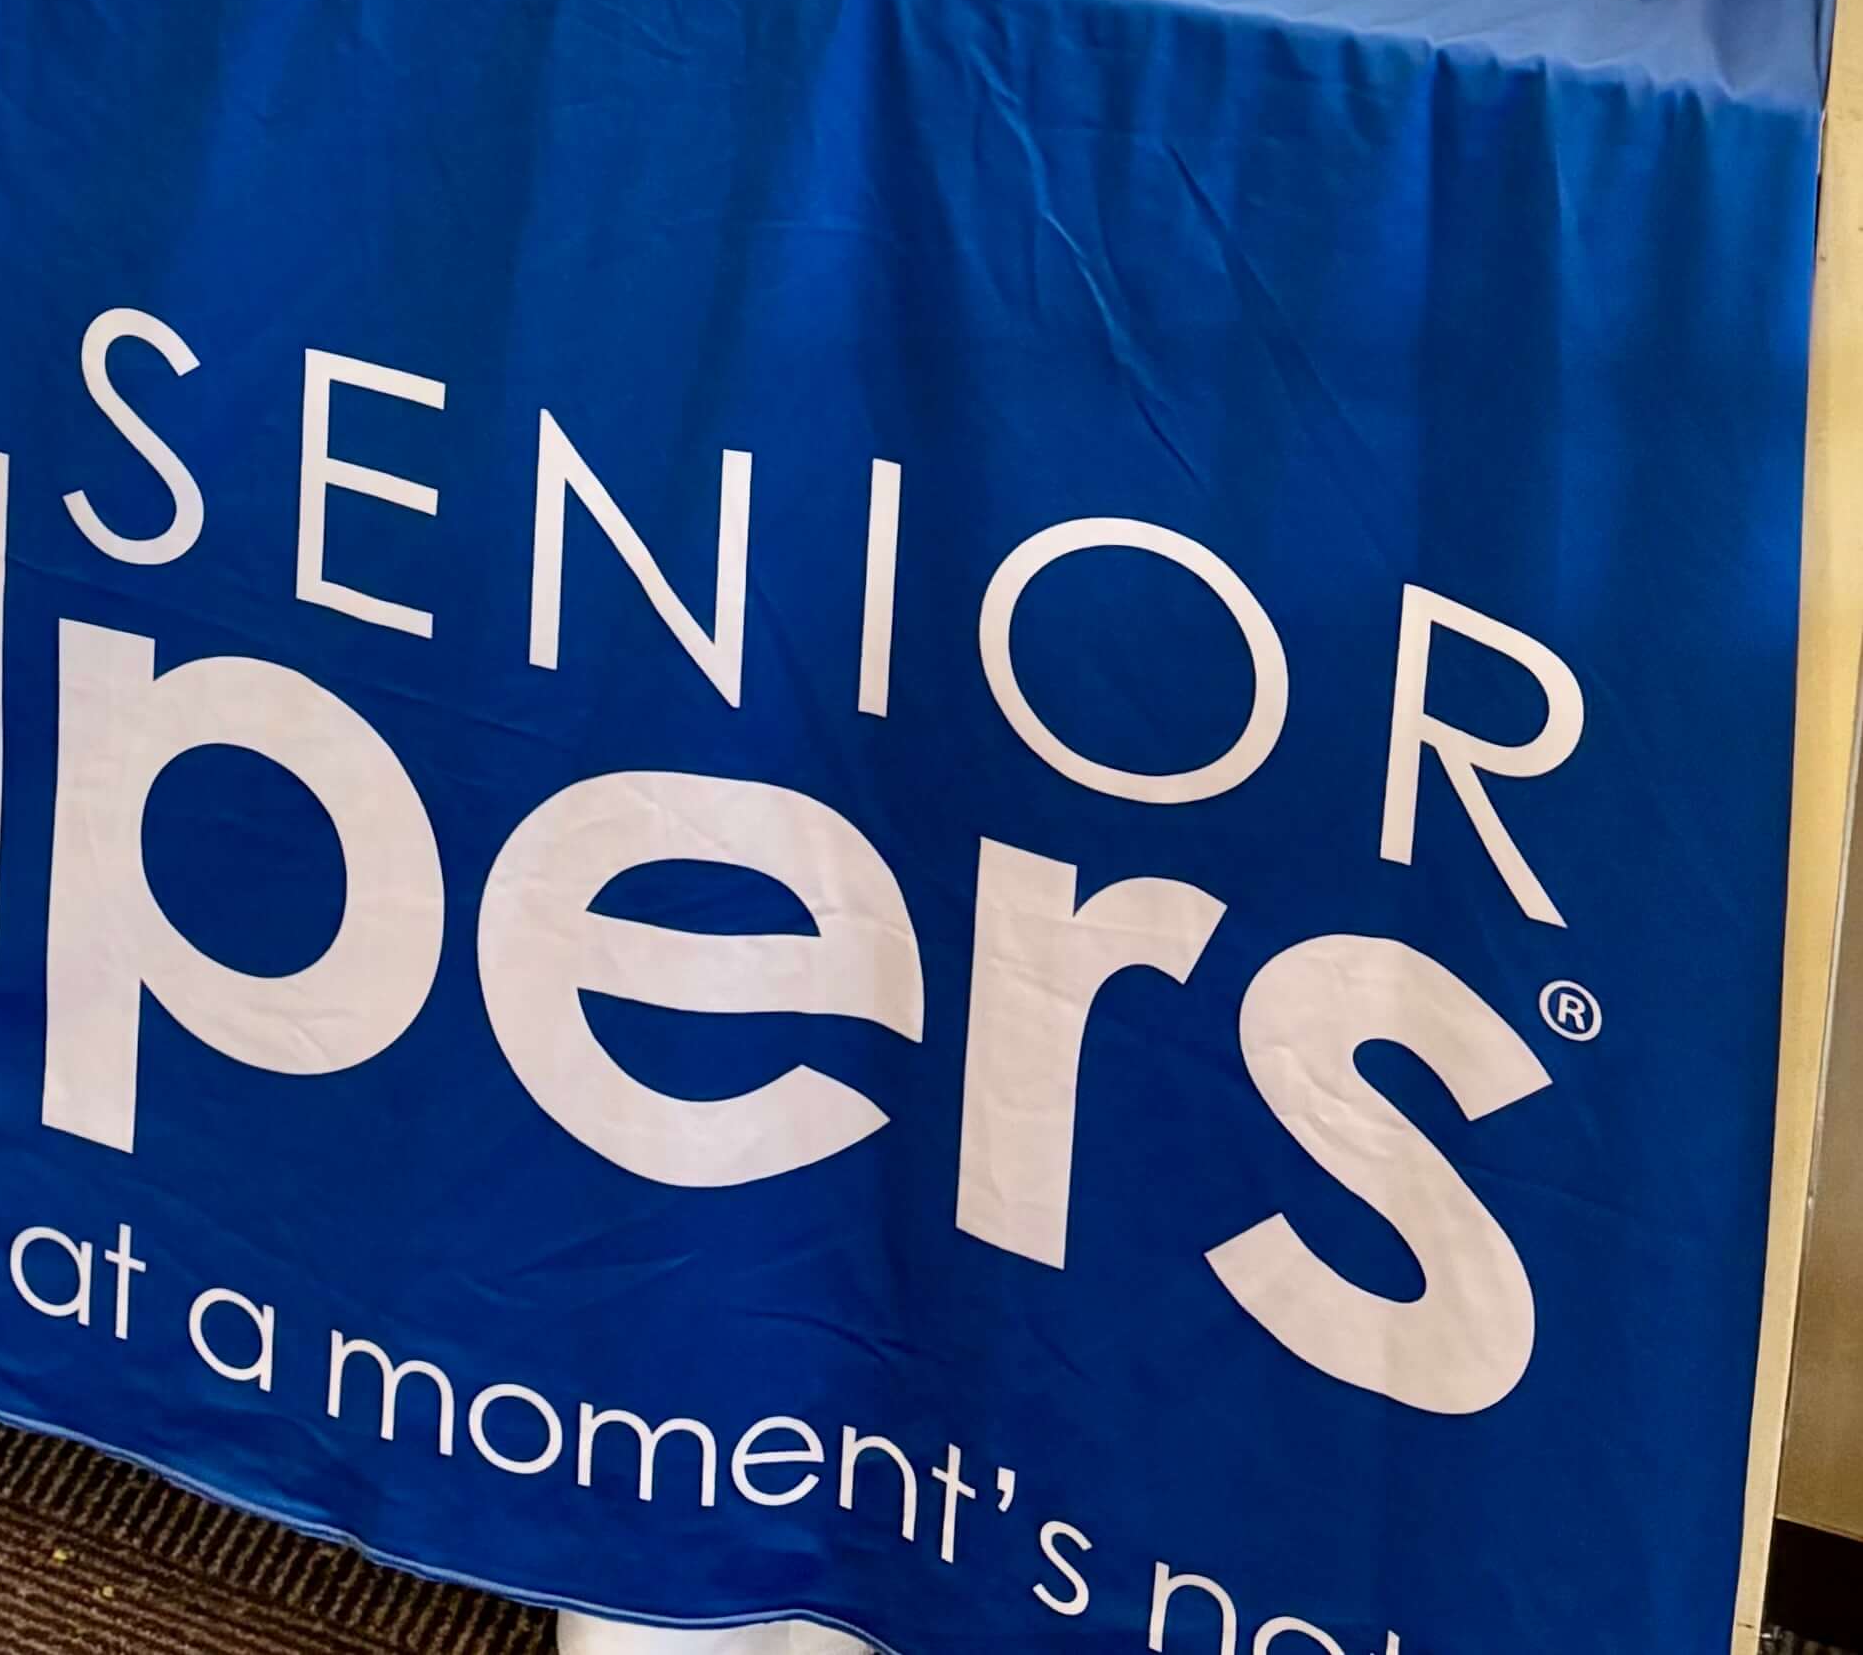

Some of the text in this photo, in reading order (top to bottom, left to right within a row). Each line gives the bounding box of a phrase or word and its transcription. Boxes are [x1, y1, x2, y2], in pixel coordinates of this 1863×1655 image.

[63, 308, 1584, 929] SENIOR
[10, 1227, 146, 1339] at
[189, 1288, 274, 1391] a
[328, 1330, 1092, 1615] moment's
